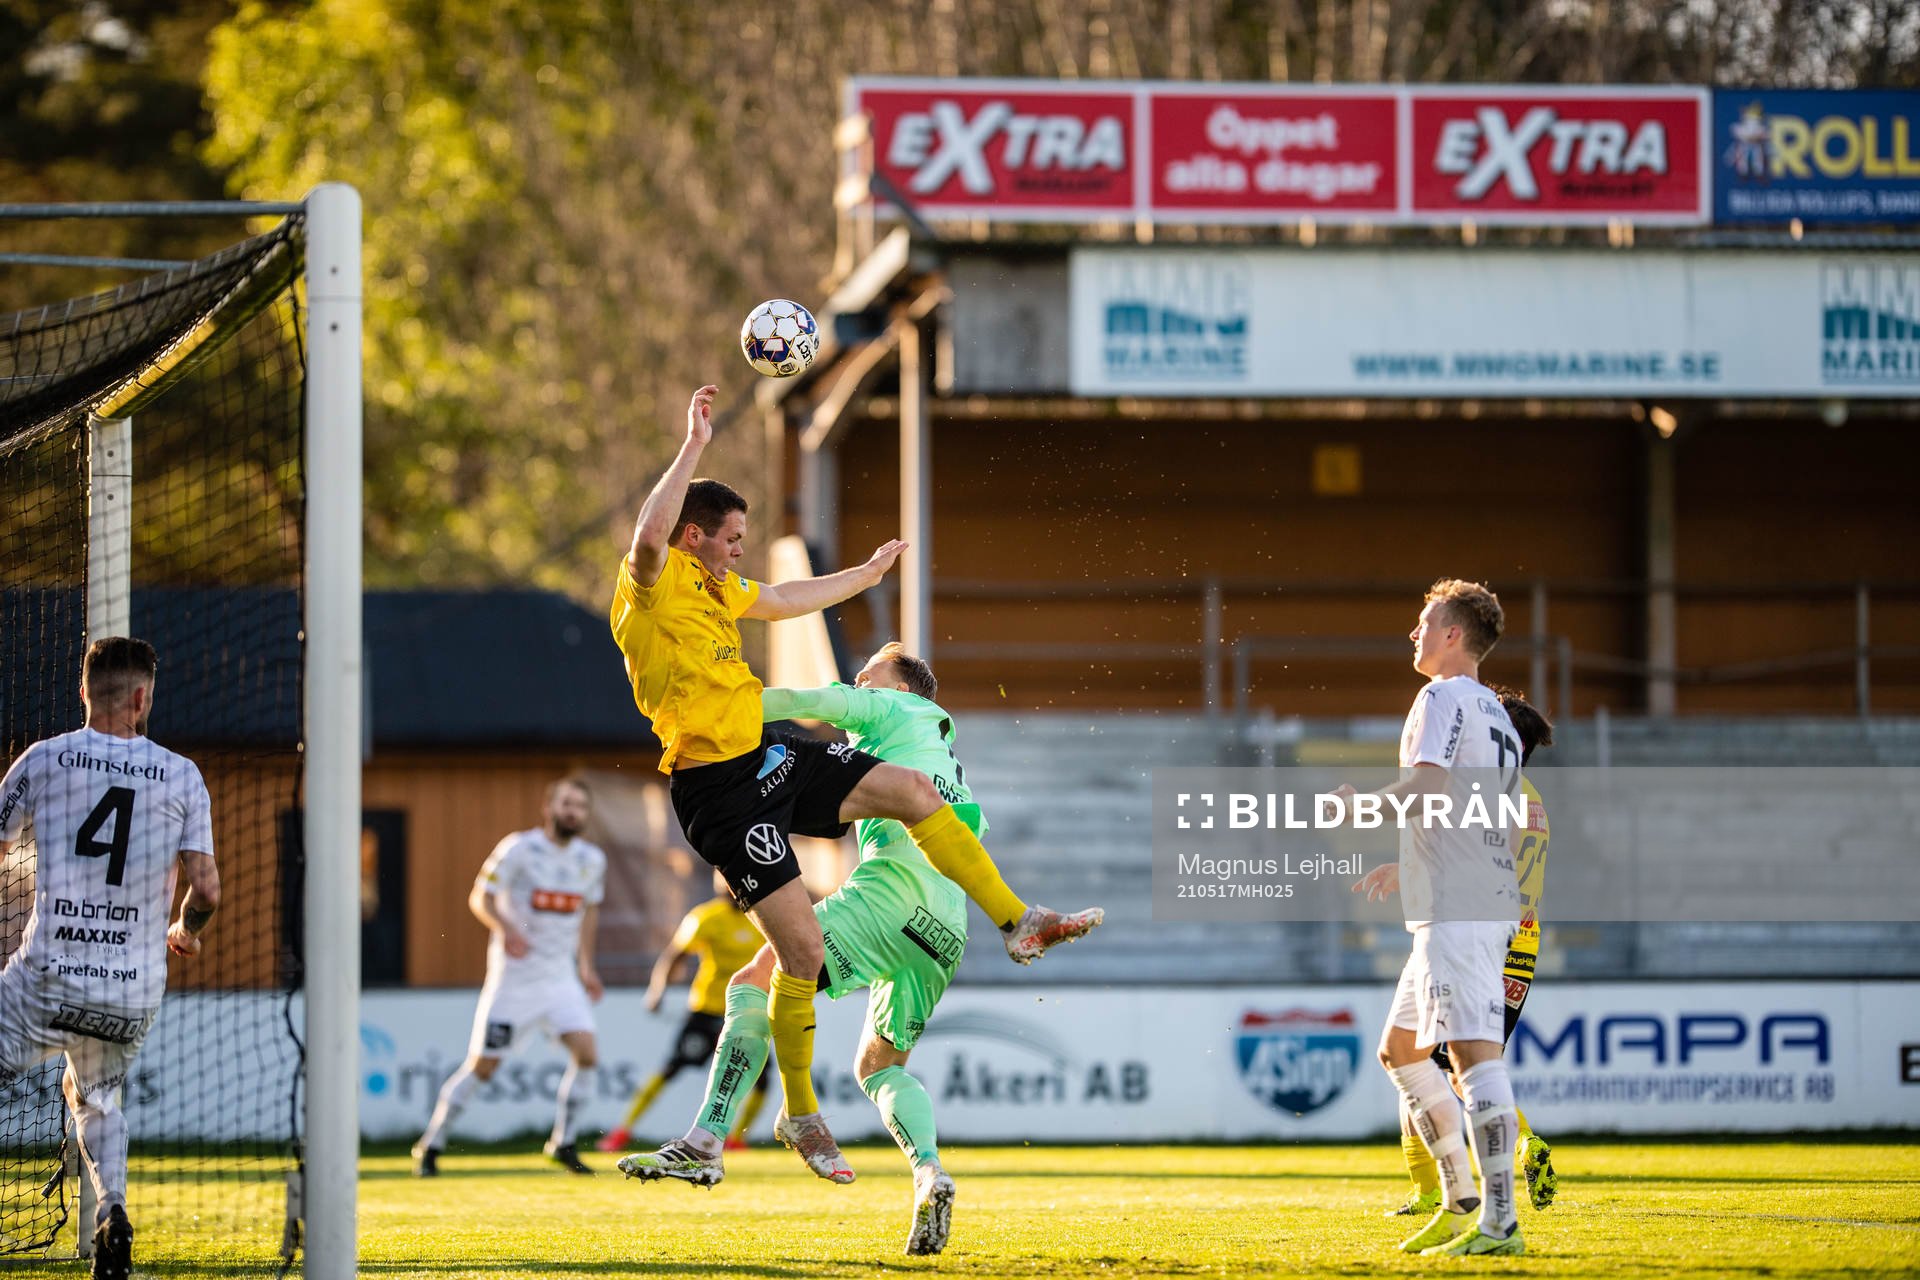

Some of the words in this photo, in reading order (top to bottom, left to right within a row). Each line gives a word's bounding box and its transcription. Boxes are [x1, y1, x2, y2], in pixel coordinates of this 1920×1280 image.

[1208, 104, 1338, 155] Öppet
[1166, 157, 1247, 191] alla
[1256, 157, 1380, 199] dagar
[57, 750, 167, 782] Glimstedt
[75, 786, 136, 887] 4
[741, 875, 759, 892] 16
[81, 899, 139, 922] brion
[54, 926, 127, 945] MAXXIS
[57, 965, 108, 979] prefab
[112, 967, 137, 983] syd
[57, 1003, 145, 1041] DEMO
[1514, 1014, 1830, 1066] MAPA
[942, 1052, 1066, 1102] Åkeri
[1084, 1061, 1150, 1102] AB
